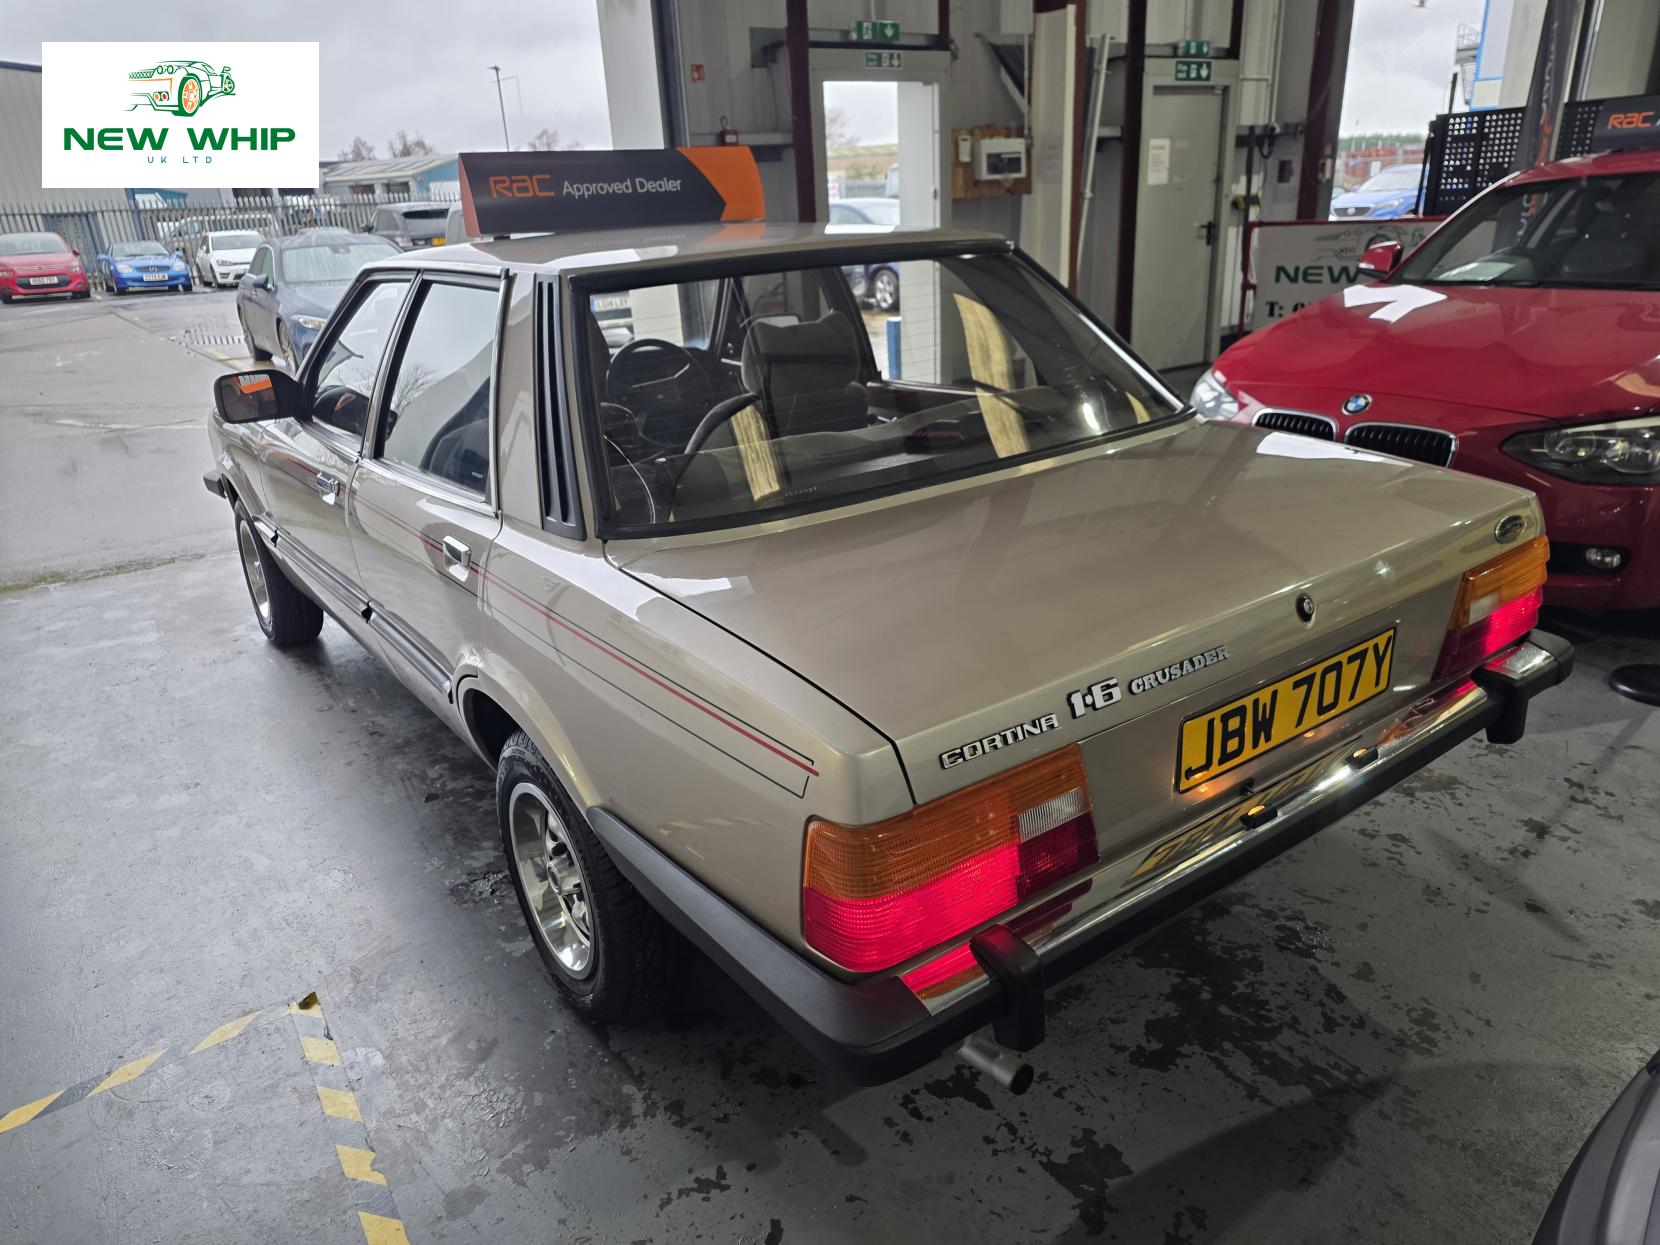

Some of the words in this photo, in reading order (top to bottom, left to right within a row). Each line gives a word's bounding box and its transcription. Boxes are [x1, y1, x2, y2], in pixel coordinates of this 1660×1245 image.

[562, 177, 633, 200] Approved
[635, 176, 682, 194] Dealer
[1274, 264, 1360, 284] NEW
[938, 712, 1060, 770] CORTINA
[1128, 645, 1231, 696] CRUSADER
[1184, 688, 1279, 781] JBW
[1291, 634, 1393, 730] 707Y
